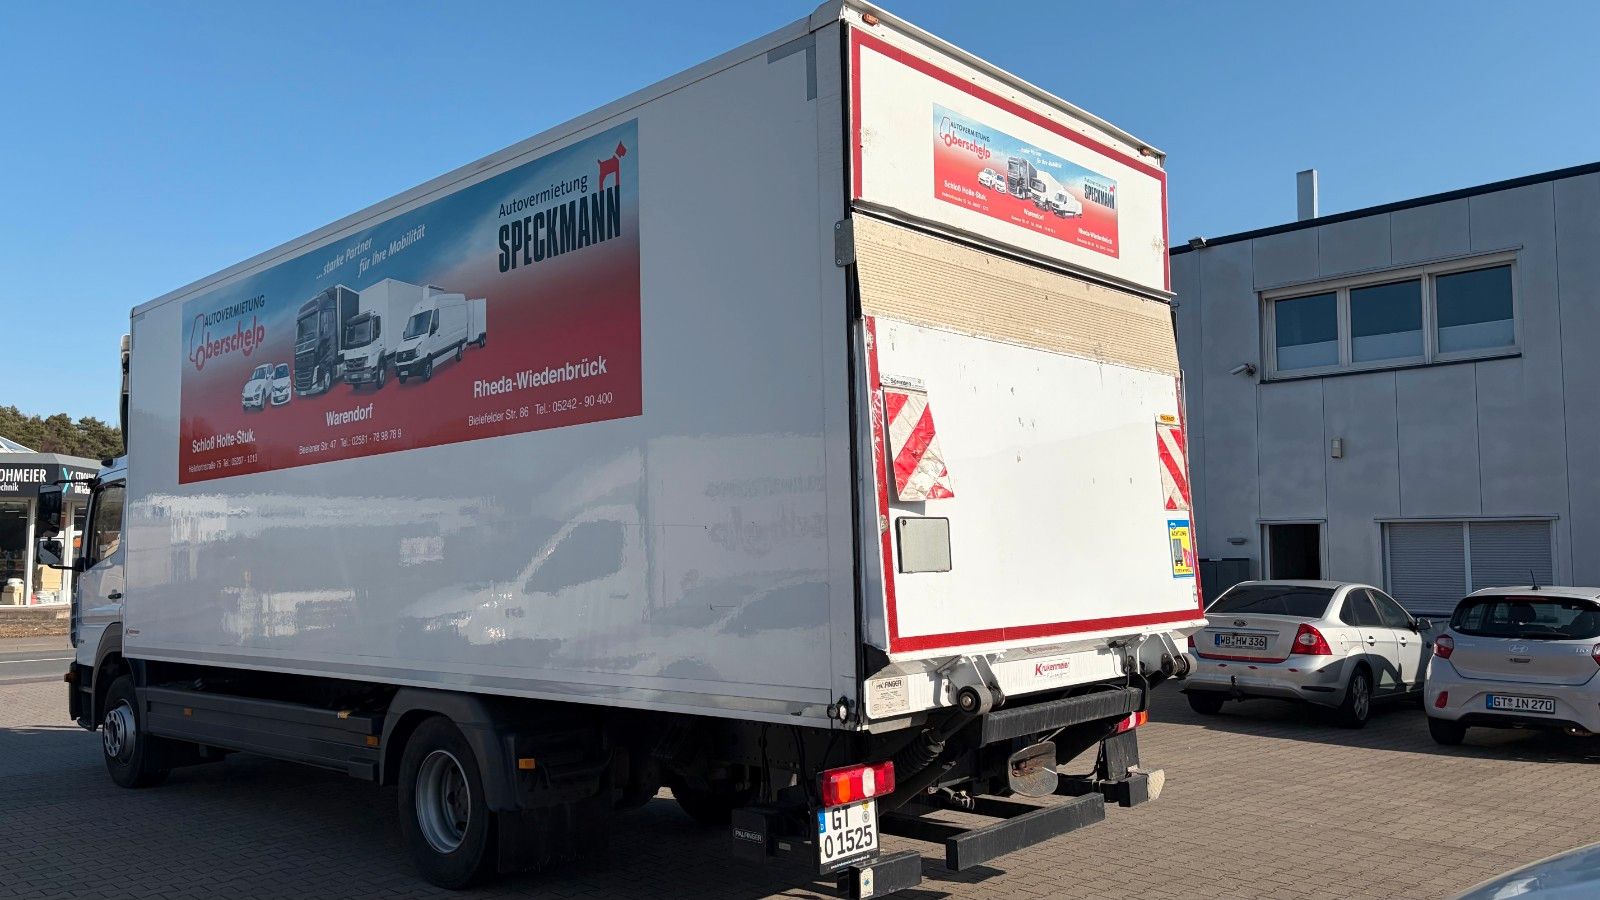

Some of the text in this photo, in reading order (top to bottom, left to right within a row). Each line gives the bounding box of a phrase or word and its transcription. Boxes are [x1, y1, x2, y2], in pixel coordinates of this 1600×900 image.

[944, 131, 991, 159] Oberschelp
[950, 121, 990, 142] AUTOVERMIETUNG
[498, 175, 588, 218] Autovermietung
[498, 184, 621, 273] SPECKMANN
[345, 236, 373, 262] Partner
[357, 258, 371, 278] für
[388, 223, 426, 257] Mobilität
[204, 294, 265, 328] AUTOVERMIETUNG
[195, 316, 265, 371] Oberschelp
[473, 355, 607, 398] Rheda-Wiedenbrück
[326, 402, 374, 427] Warendorf
[468, 411, 504, 427] Bielefelder
[505, 408, 518, 421] Str.
[519, 406, 529, 418] 86
[552, 398, 577, 413] 05242
[584, 395, 595, 407] 90
[597, 391, 613, 405] 400
[192, 428, 256, 453] Schloß Holte-Stuk.
[1220, 635, 1265, 647] WB HW 336
[1493, 696, 1553, 711] GT IN 270
[832, 805, 851, 830] GT
[837, 824, 873, 855] 1525
